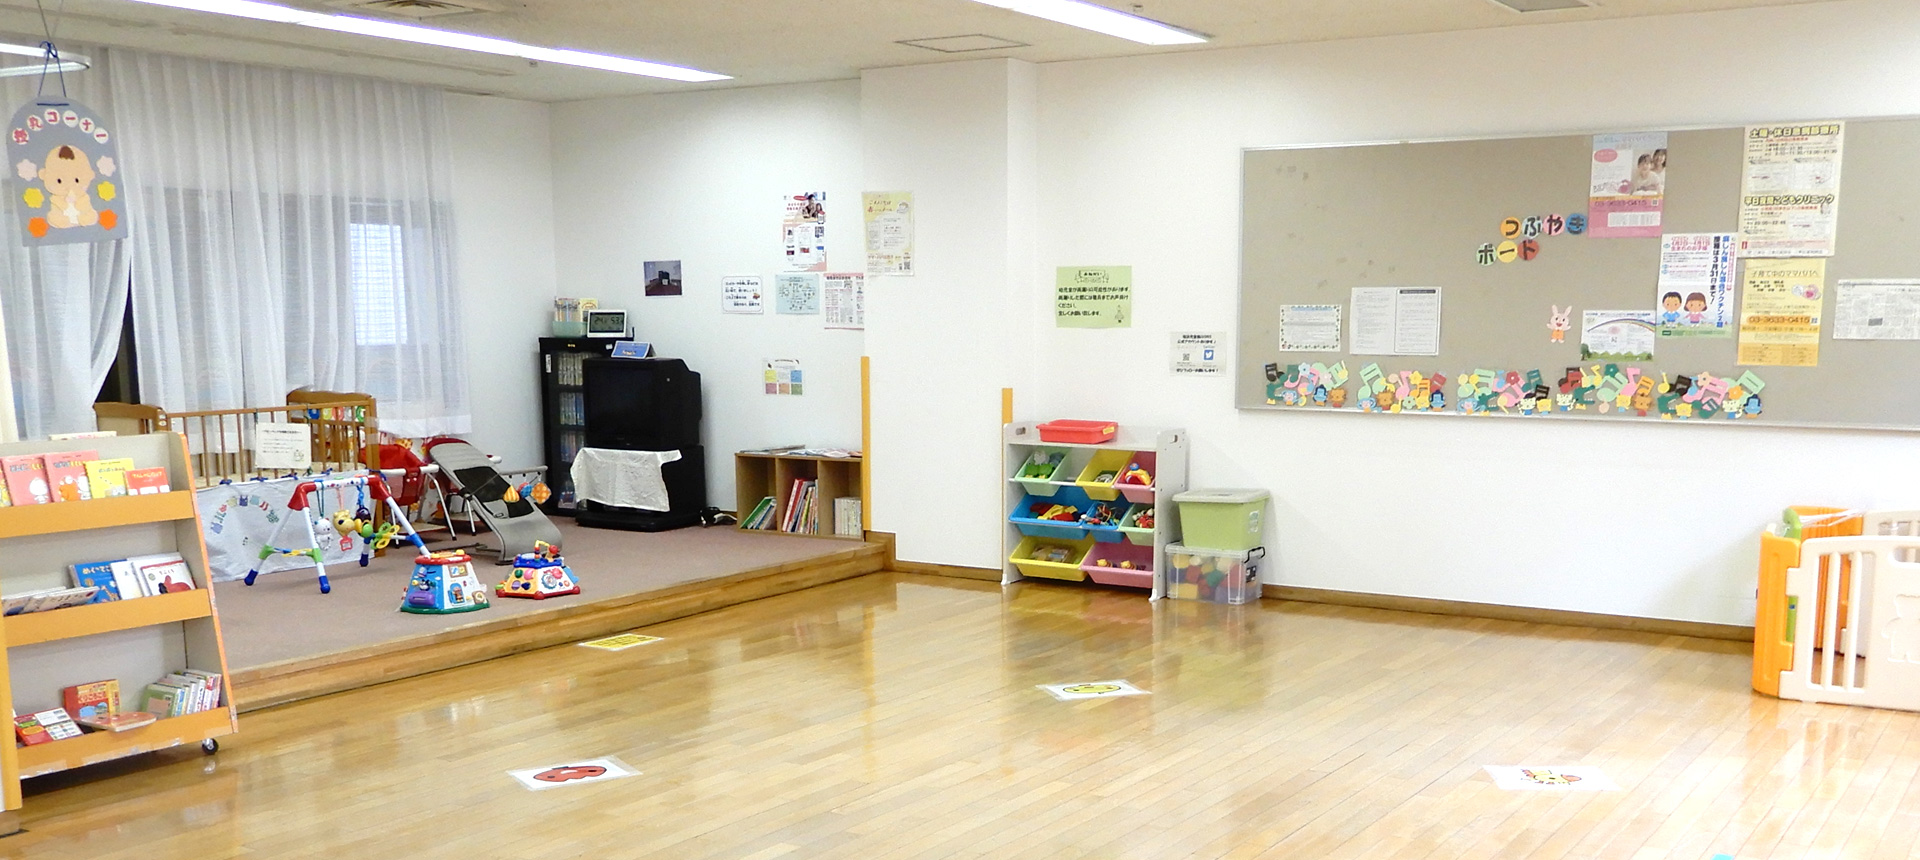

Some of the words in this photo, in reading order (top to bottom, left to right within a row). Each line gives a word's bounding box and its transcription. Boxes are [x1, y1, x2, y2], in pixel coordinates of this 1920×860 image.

[1506, 214, 1584, 237] つぶやき
[1478, 239, 1535, 265] ボード
